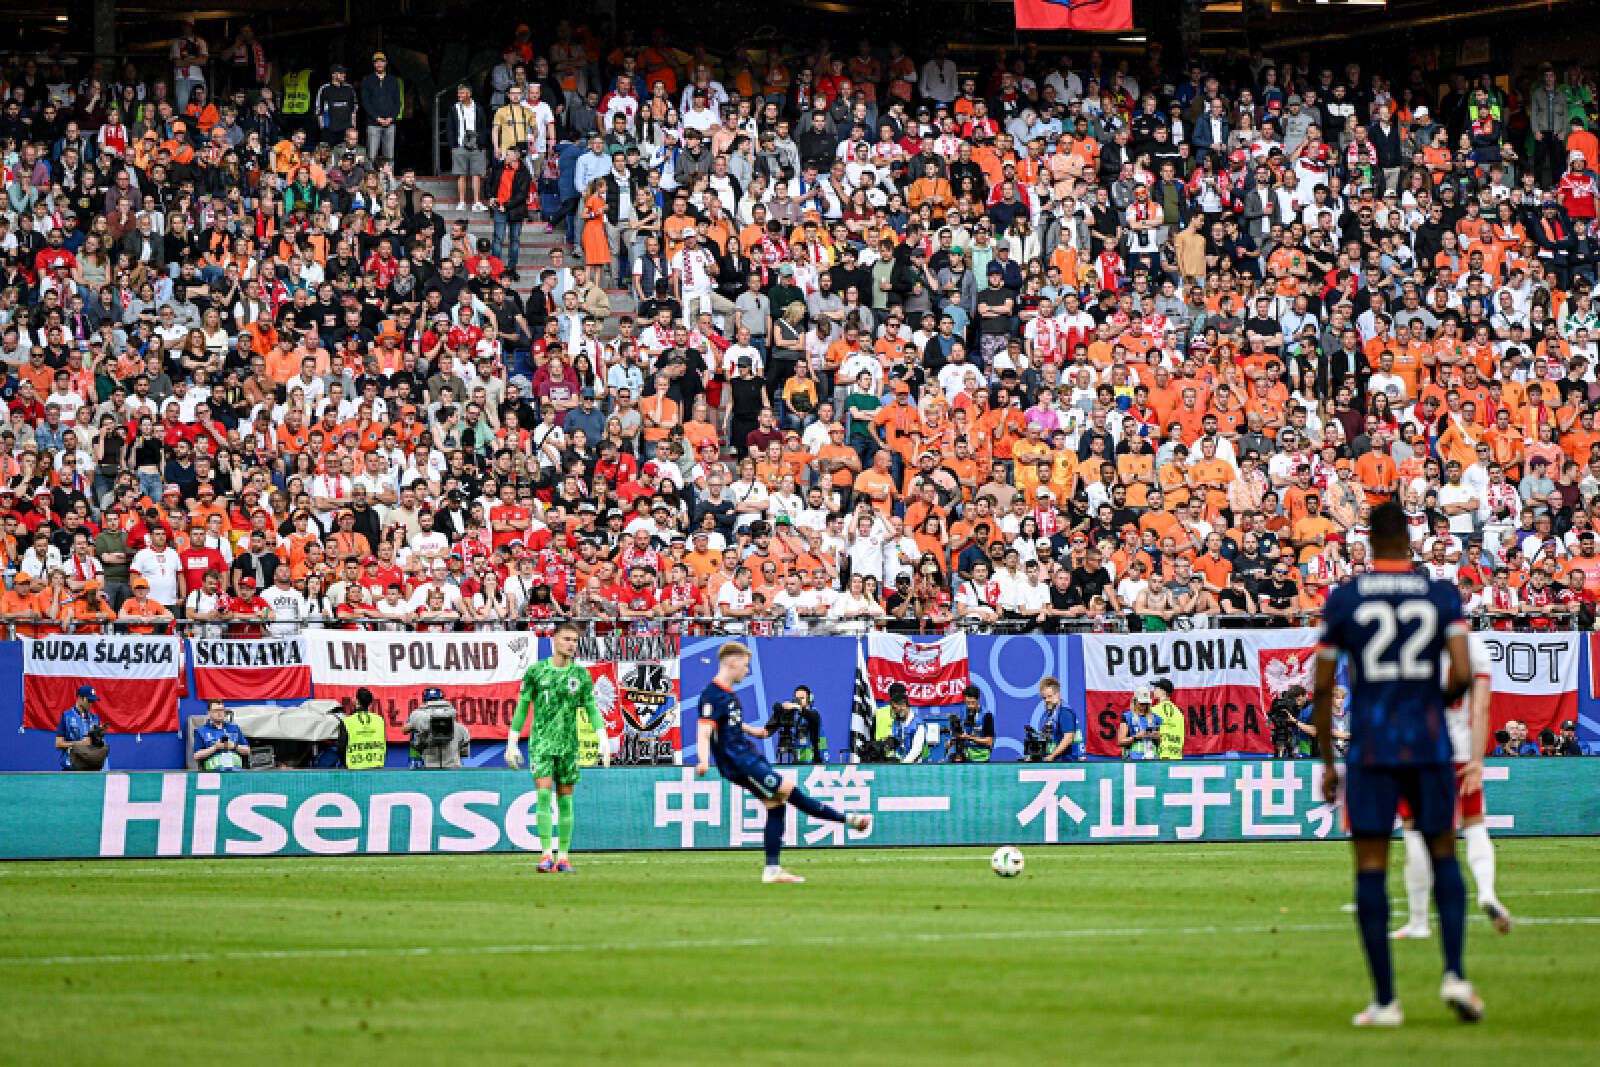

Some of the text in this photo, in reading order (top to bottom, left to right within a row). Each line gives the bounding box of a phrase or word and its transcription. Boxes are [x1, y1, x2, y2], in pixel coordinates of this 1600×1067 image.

[32, 638, 173, 669] RUDA ŚLĄSKA
[327, 641, 499, 672] LM POLAND
[1105, 638, 1248, 677] POLONIA
[1354, 600, 1438, 681] 22
[1484, 640, 1568, 683] POT
[1098, 702, 1261, 740] ŚNICA
[100, 771, 560, 856] Hisense
